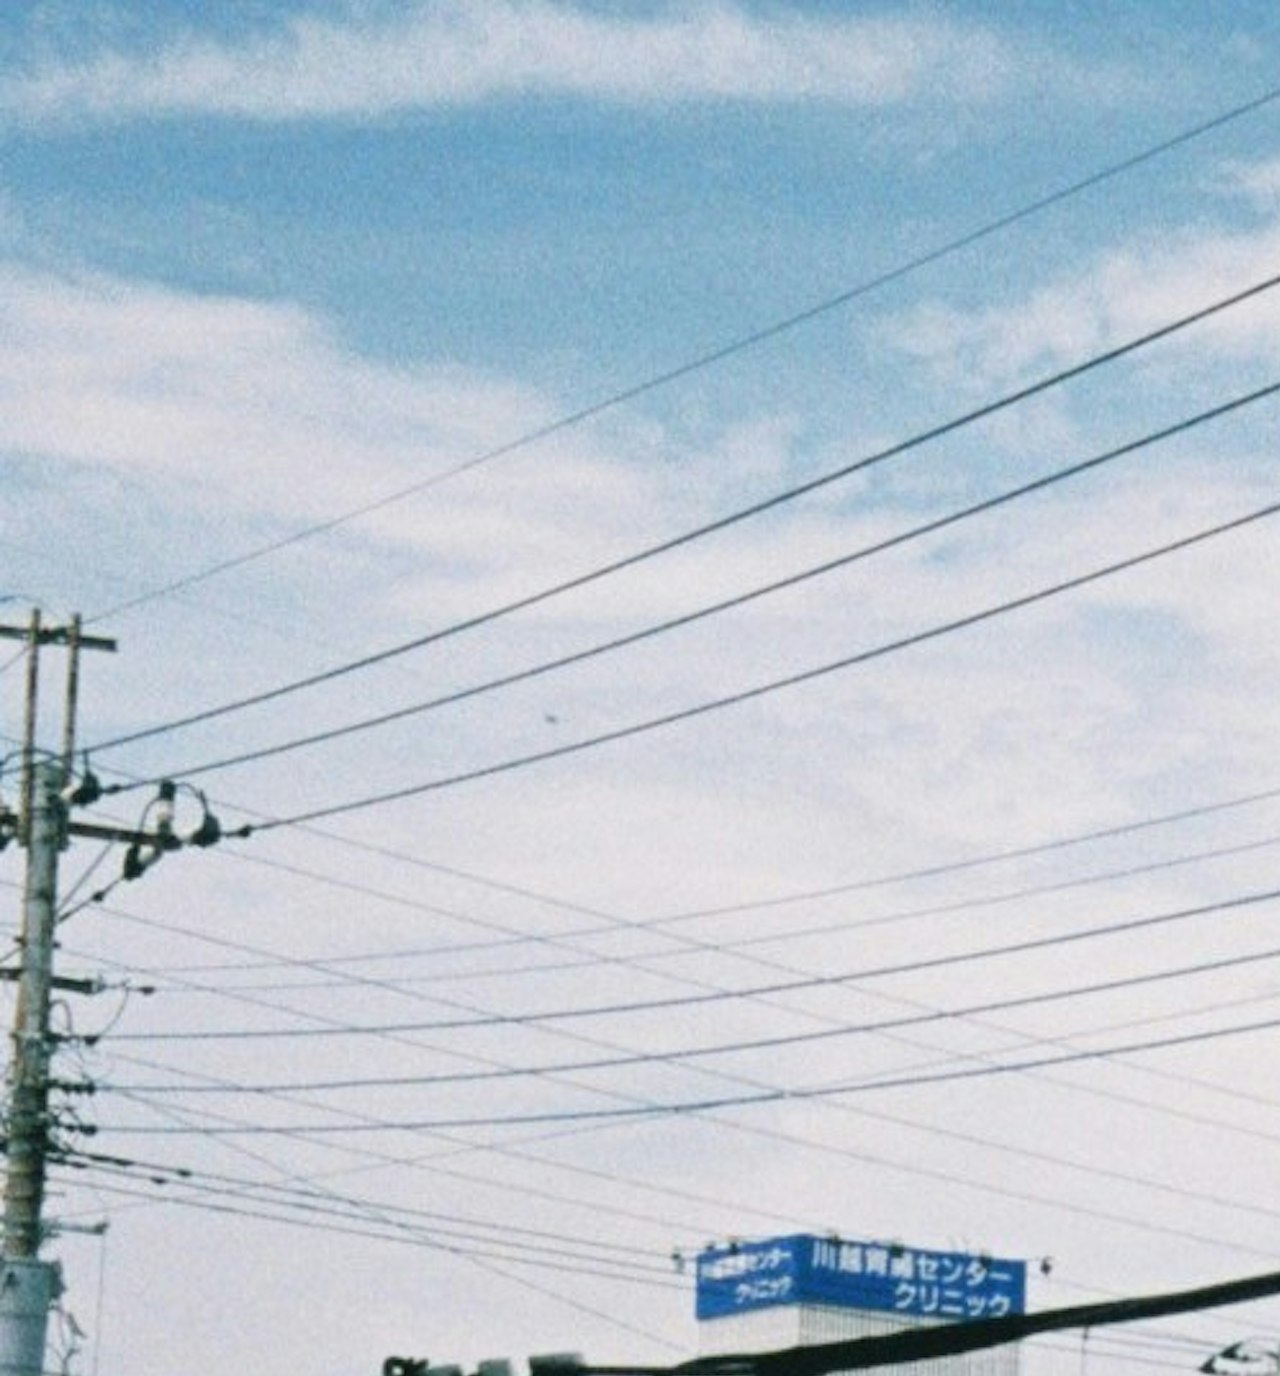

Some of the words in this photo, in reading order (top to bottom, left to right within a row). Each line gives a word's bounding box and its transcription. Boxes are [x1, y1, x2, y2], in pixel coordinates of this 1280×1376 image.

[894, 1282, 1012, 1317] クリニック
